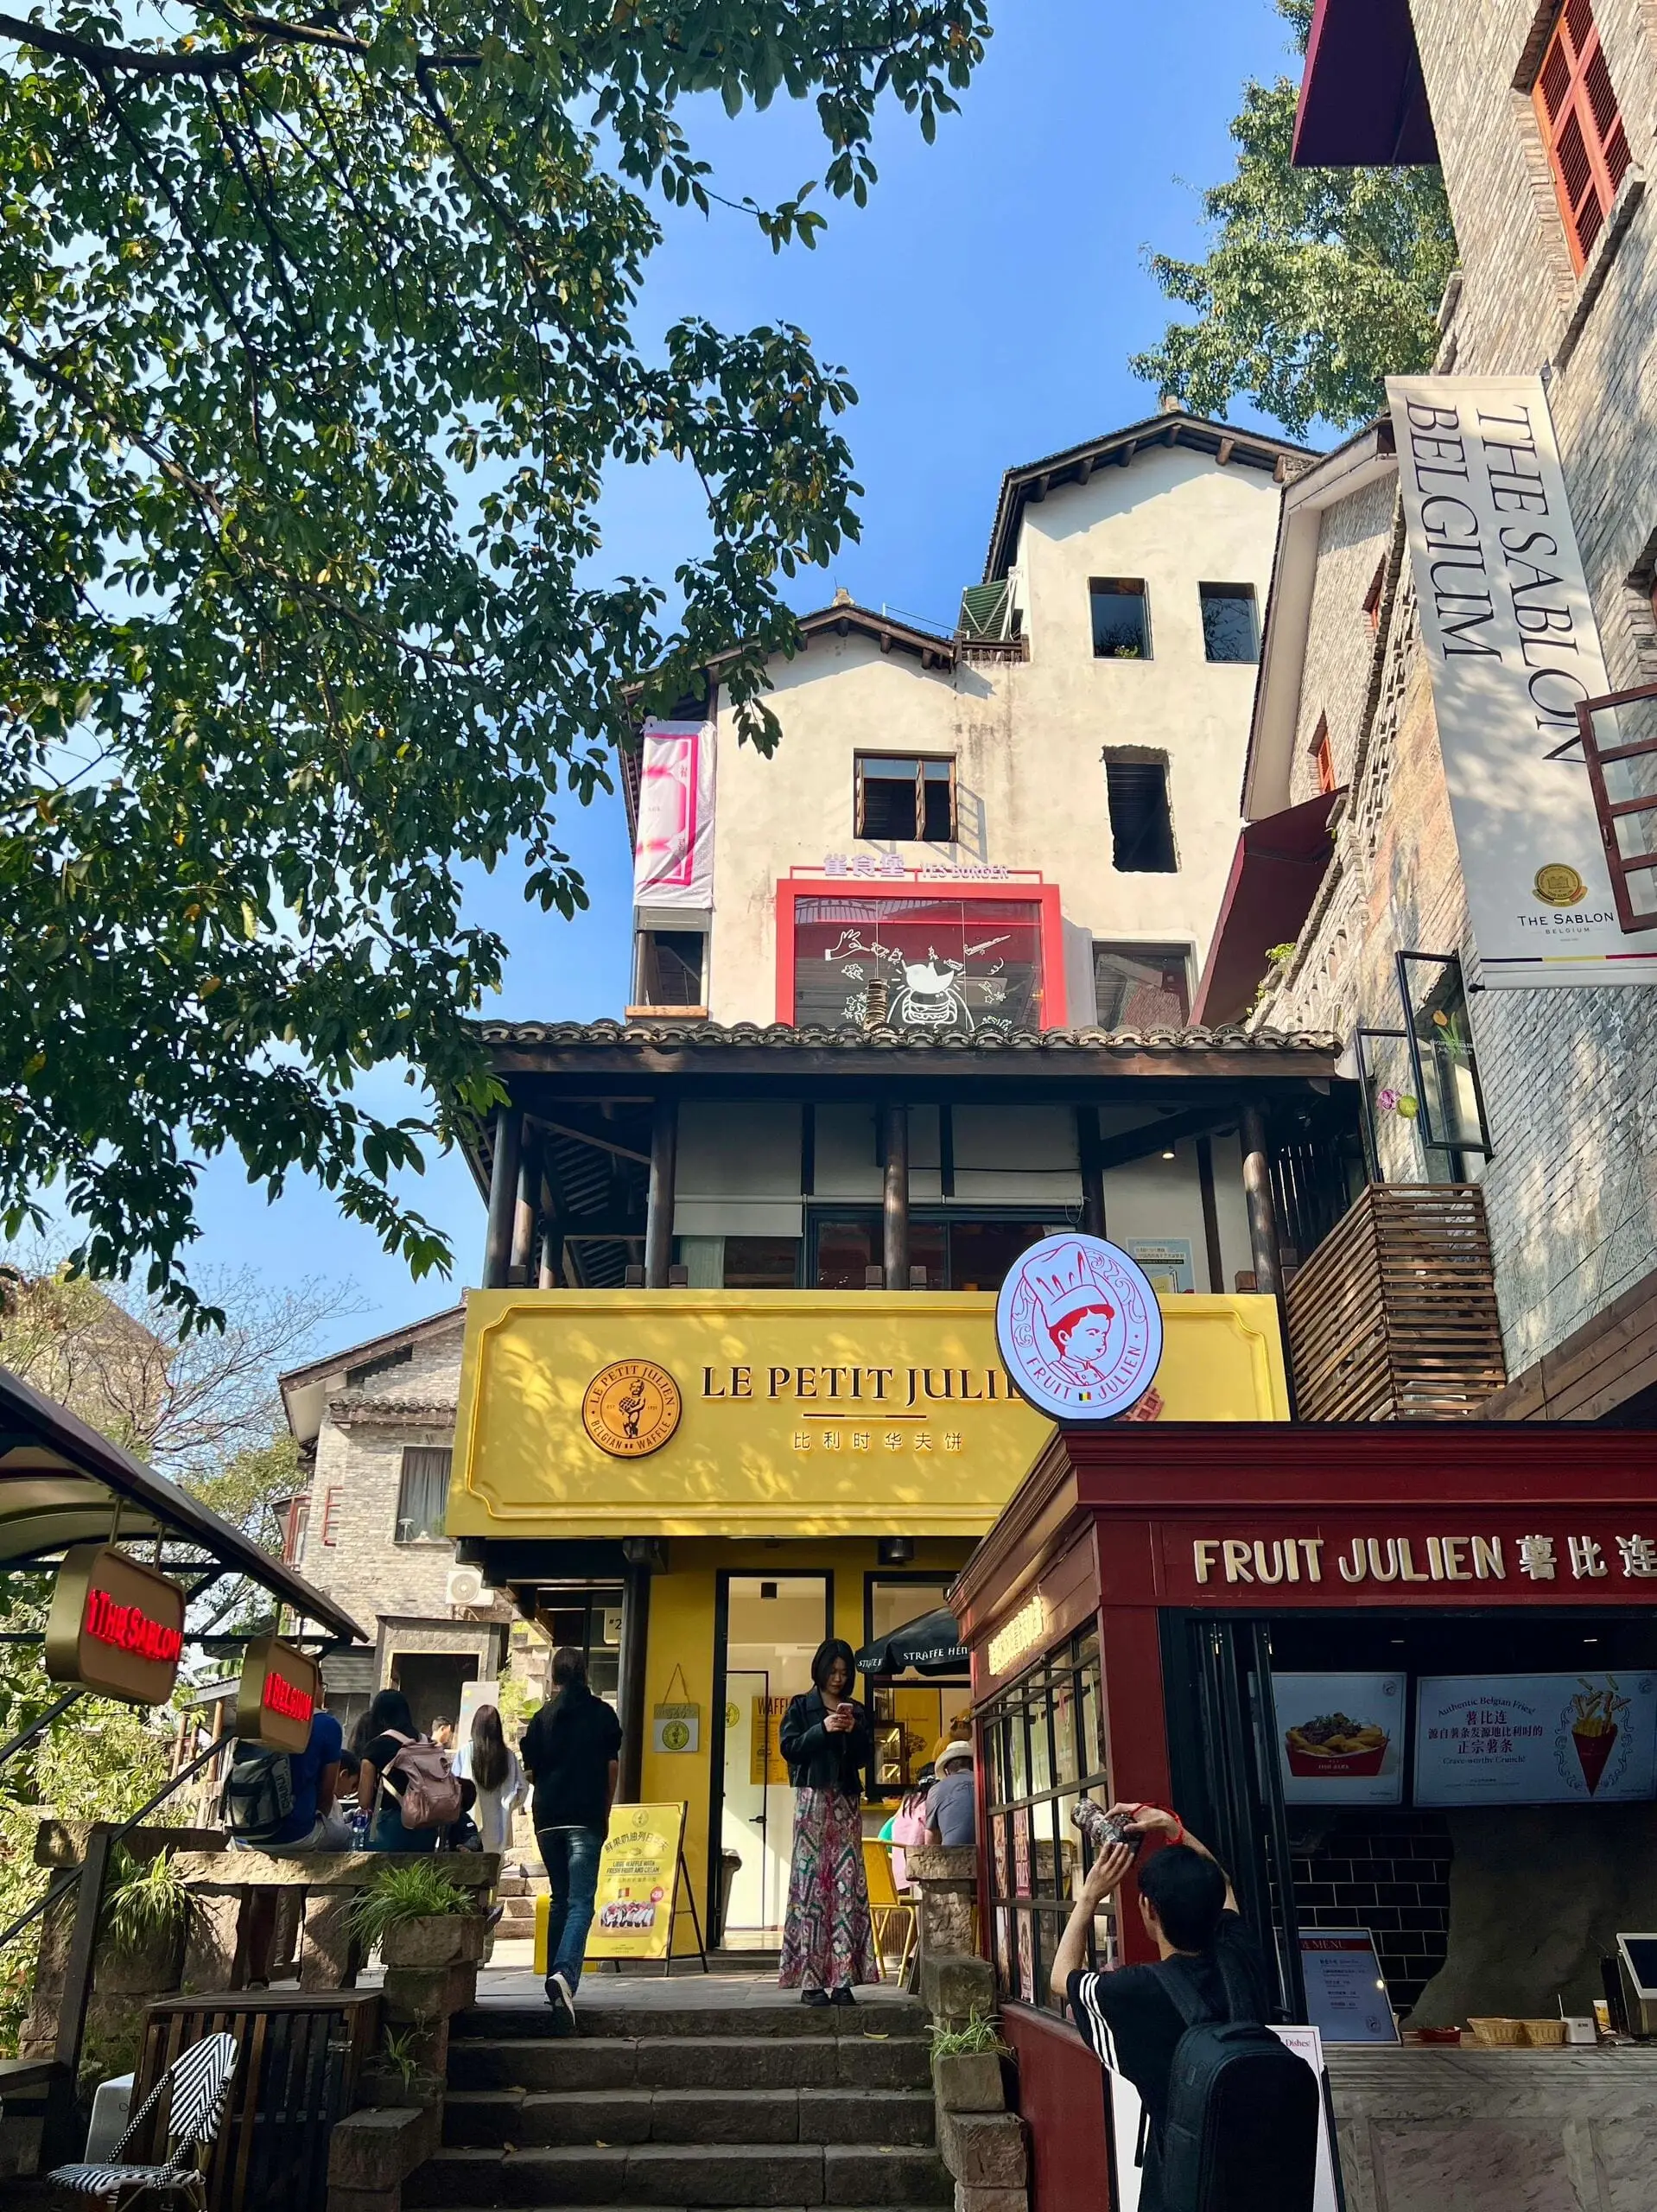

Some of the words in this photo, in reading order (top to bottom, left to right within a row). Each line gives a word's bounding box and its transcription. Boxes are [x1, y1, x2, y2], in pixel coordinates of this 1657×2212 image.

[1476, 404, 1550, 517] THE
[1406, 396, 1503, 663] BELGIUM
[1499, 525, 1590, 763] SABLON
[920, 862, 948, 879] YES
[950, 864, 1009, 880] BURGER
[1517, 915, 1548, 926] THE
[1553, 912, 1615, 925] SABLON
[589, 1388, 603, 1404] LE
[600, 1365, 639, 1387] PETIT
[642, 1367, 675, 1406] JULIEN
[1026, 1357, 1072, 1400] FRUIT
[1098, 1346, 1141, 1400] JULIEN
[701, 1366, 753, 1399] LE
[766, 1367, 894, 1400] PETIT
[905, 1368, 1024, 1407] JULI
[591, 1420, 622, 1449] BELGIAN
[637, 1421, 670, 1450] WAFFLE
[793, 1430, 963, 1452] 比利时华夫饼
[1193, 1538, 1325, 1584] FRUIT
[1338, 1535, 1507, 1582] JULIEN
[1518, 1534, 1657, 1581] 薯比连
[904, 1648, 944, 1661] STRAFFE
[1438, 1698, 1477, 1717] Authentic
[1480, 1697, 1511, 1707] Belgian
[1466, 1711, 1508, 1725] 薯比连
[1428, 1726, 1543, 1739] 源自薯条发源地比利时的
[1457, 1738, 1514, 1755] 正宗薯条
